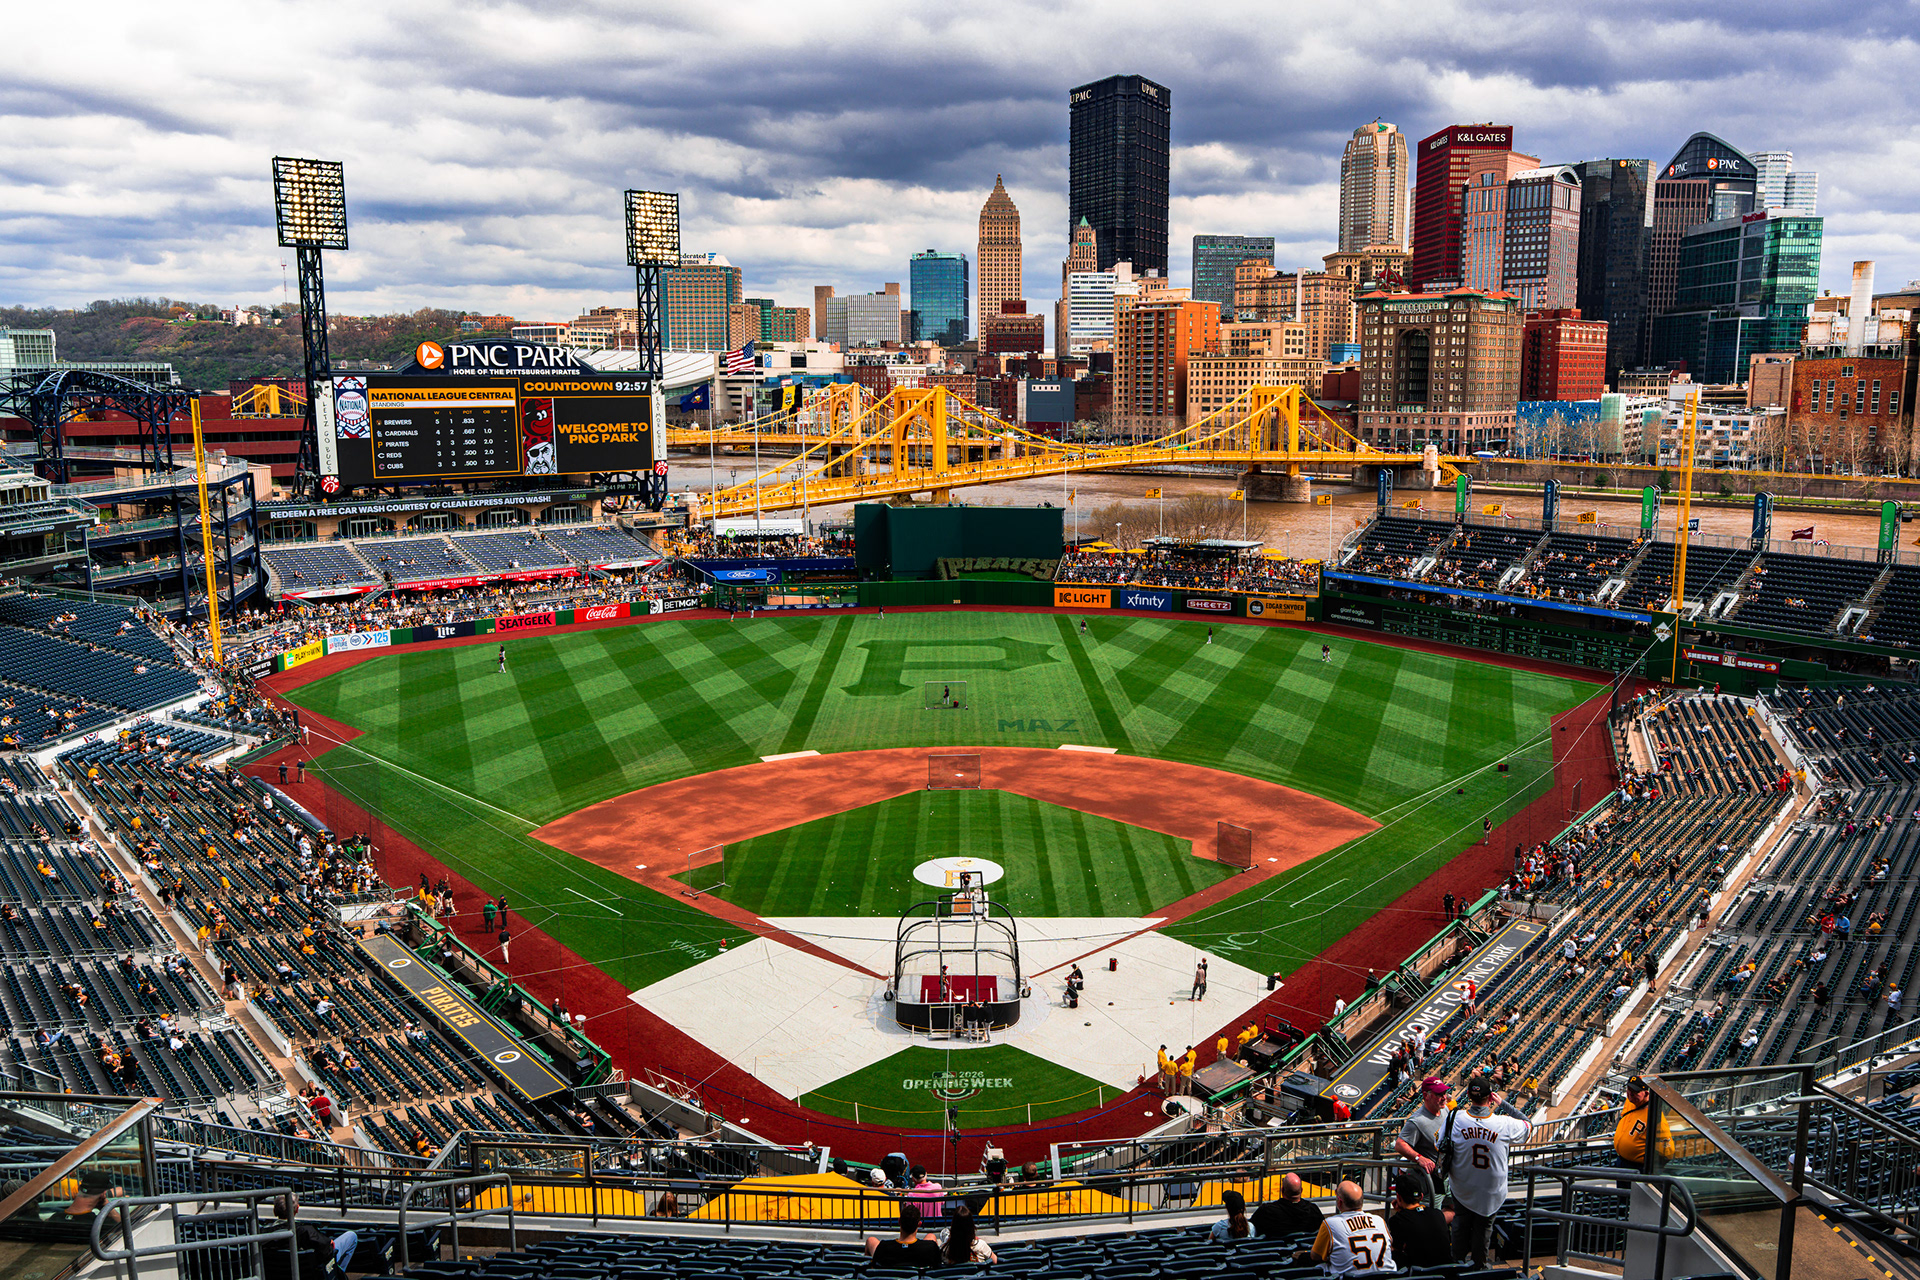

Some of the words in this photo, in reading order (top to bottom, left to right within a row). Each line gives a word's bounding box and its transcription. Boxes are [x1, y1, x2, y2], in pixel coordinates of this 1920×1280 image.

[1070, 89, 1092, 104] UPMC
[1142, 82, 1158, 98] UPMC
[1458, 133, 1474, 142] K&L
[1476, 134, 1506, 142] GATES
[1675, 162, 1688, 174] PNC
[1718, 160, 1740, 170] PNC
[449, 345, 508, 367] PNC
[514, 345, 581, 367] PARK
[524, 382, 613, 391] COUNTDOWN
[615, 382, 648, 391] 92:57
[340, 400, 364, 412] NATIONAL
[558, 423, 628, 434] WELCOME
[631, 422, 648, 432] TO
[569, 434, 599, 444] PNC
[601, 433, 639, 443] PARK
[1324, 495, 1330, 504] P
[270, 510, 308, 519] REDEEM
[358, 505, 385, 514] WASH
[386, 503, 429, 511] COURTESY
[442, 500, 468, 508] CLEAN
[469, 498, 504, 507] EXPRESS
[504, 497, 525, 505] AUTO
[526, 496, 551, 504] WASH!
[1492, 506, 1500, 514] P
[945, 556, 1059, 581] PIRATES
[1059, 592, 1072, 603] IC
[1074, 593, 1106, 603] LIGHT
[1127, 594, 1164, 608] xfinity
[664, 599, 698, 610] BETMGM
[1190, 601, 1230, 609] SHEETZ
[499, 614, 552, 630] SEATGEEK
[373, 632, 389, 643] 125
[437, 626, 456, 638] Lite
[295, 652, 306, 661] PLAY
[311, 646, 322, 656] WIN!
[997, 719, 1079, 732] MAZ
[1515, 924, 1536, 934] P
[668, 939, 712, 960] xfinity
[1204, 933, 1258, 956] NC
[1434, 991, 1462, 1007] TO
[1461, 964, 1495, 986] PNC
[1481, 944, 1516, 965] PARK
[420, 986, 480, 1028] PIRATES
[902, 1079, 969, 1089] OPENING
[971, 1078, 1013, 1088] WEEK
[1629, 1119, 1646, 1136] P
[1460, 1127, 1498, 1144] GRIFFIN
[1472, 1143, 1490, 1170] 6
[1346, 1216, 1376, 1232] DUKE
[1348, 1233, 1387, 1269] 57
